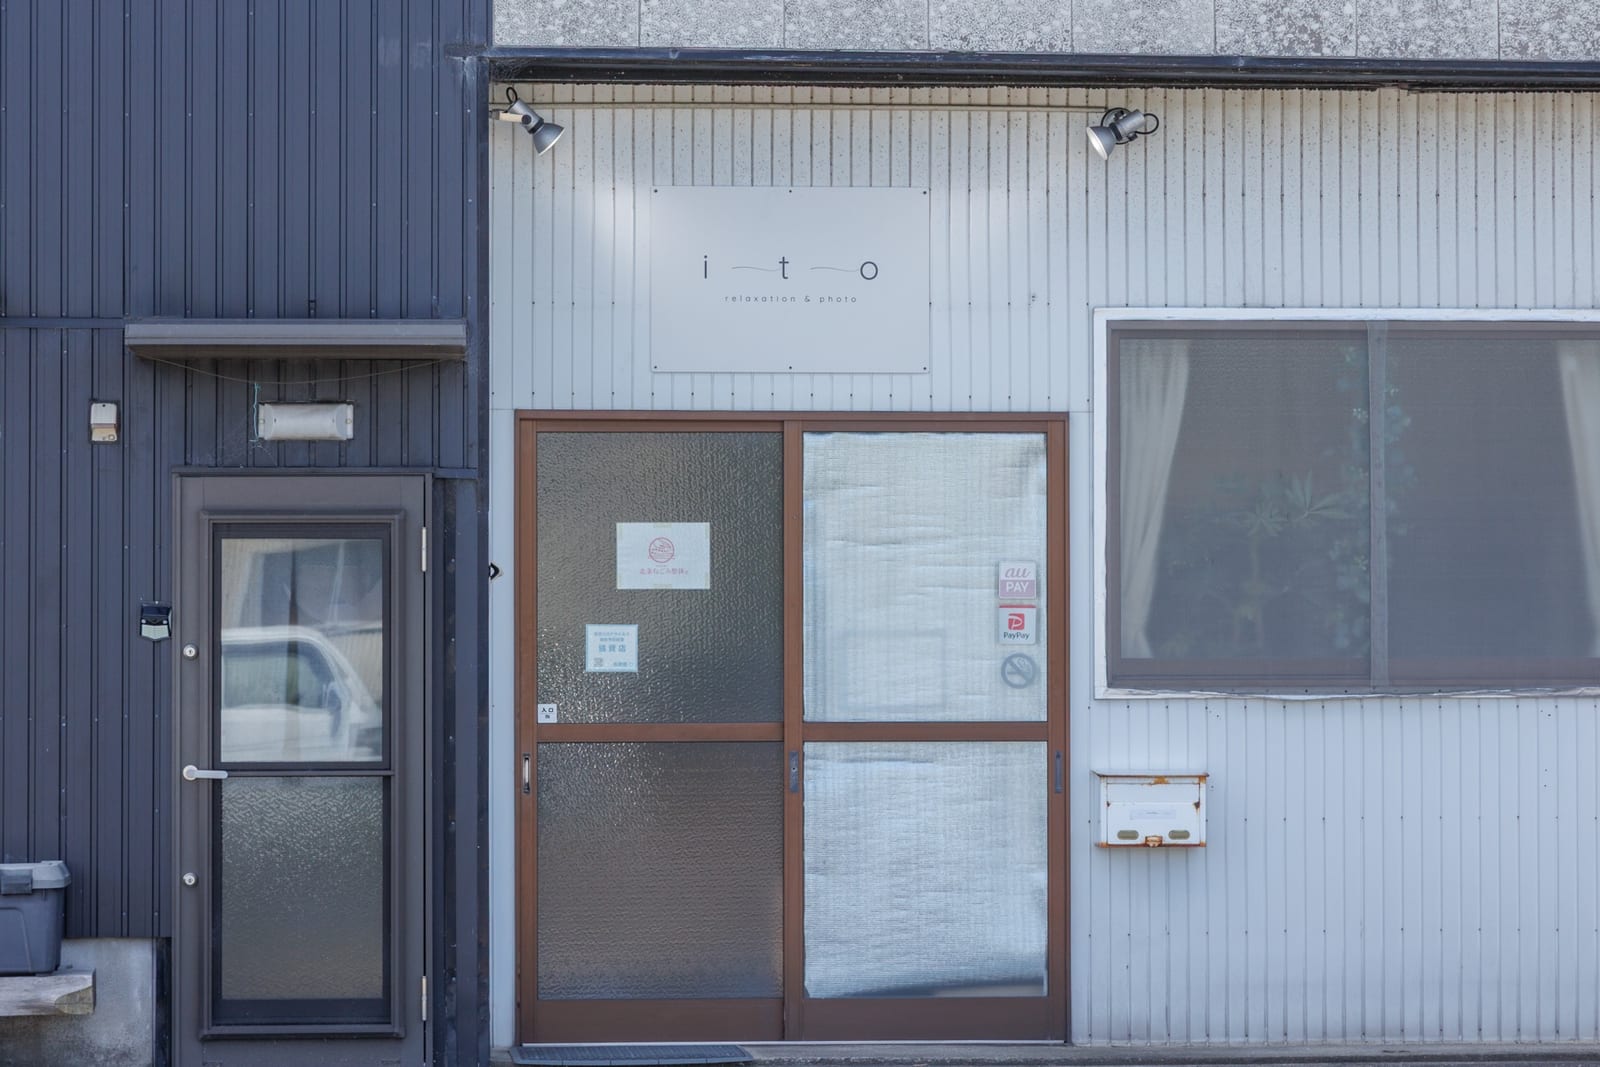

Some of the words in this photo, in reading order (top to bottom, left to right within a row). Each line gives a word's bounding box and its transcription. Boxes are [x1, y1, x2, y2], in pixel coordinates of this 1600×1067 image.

[724, 295, 796, 303] relaxation
[803, 295, 811, 303] &
[819, 295, 858, 304] photo
[1005, 582, 1029, 593] PAY
[1003, 631, 1030, 640] PayPay
